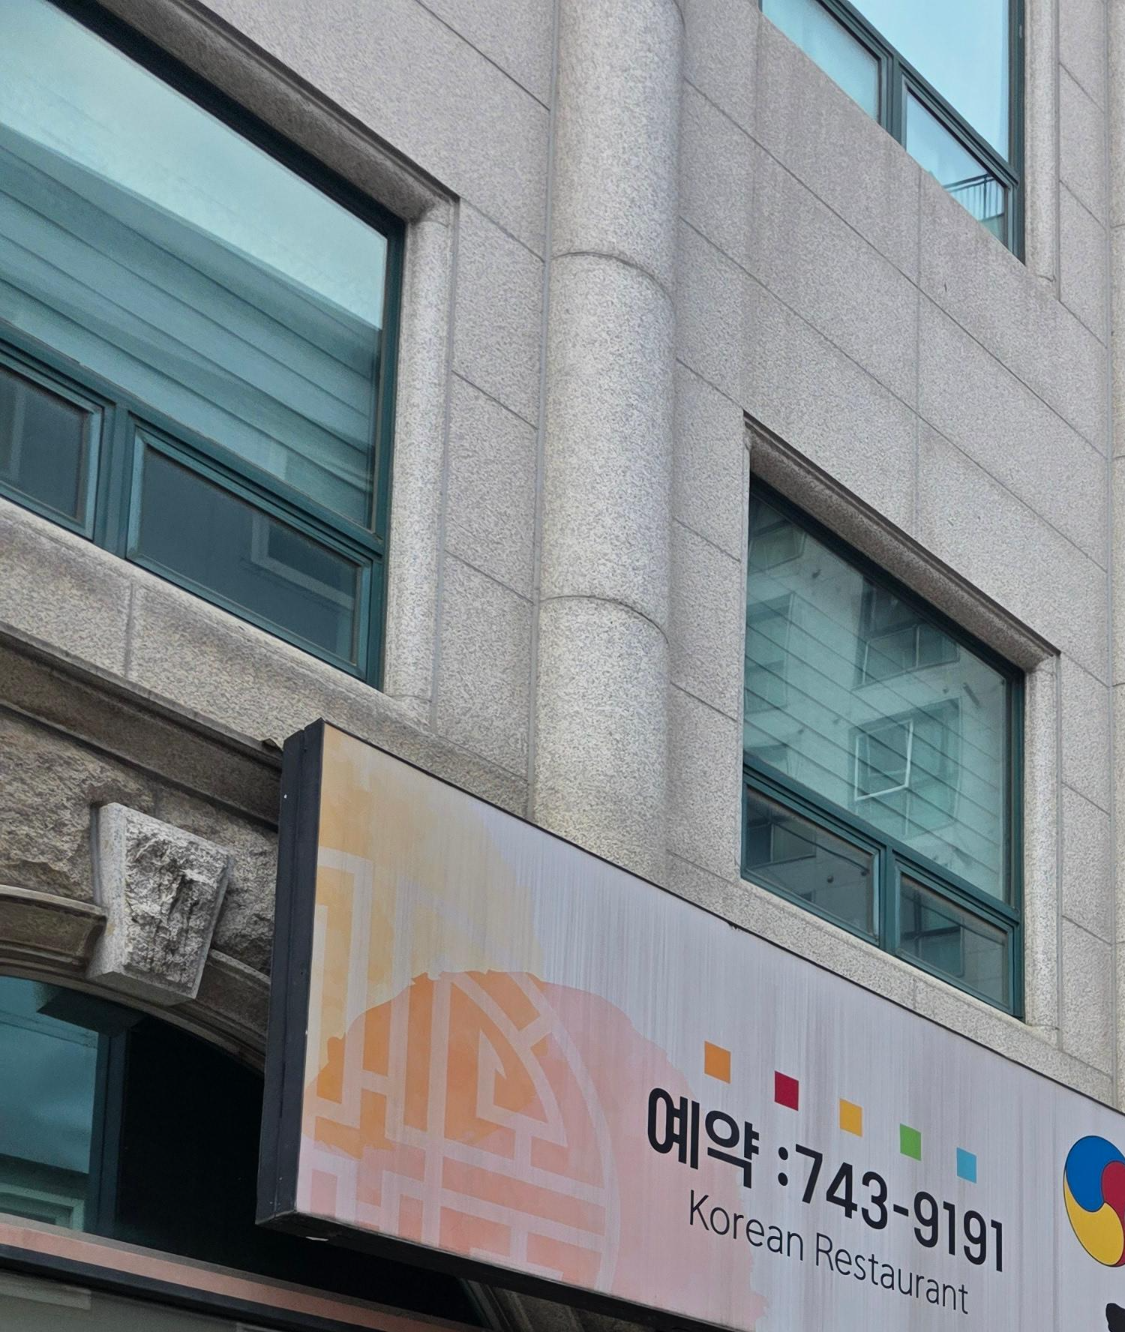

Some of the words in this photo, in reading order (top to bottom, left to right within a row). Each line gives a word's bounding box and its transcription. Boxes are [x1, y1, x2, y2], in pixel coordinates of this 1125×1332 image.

[647, 1086, 760, 1190] 예약
[688, 1189, 804, 1262] Korean
[815, 1232, 969, 1315] Restaurant
